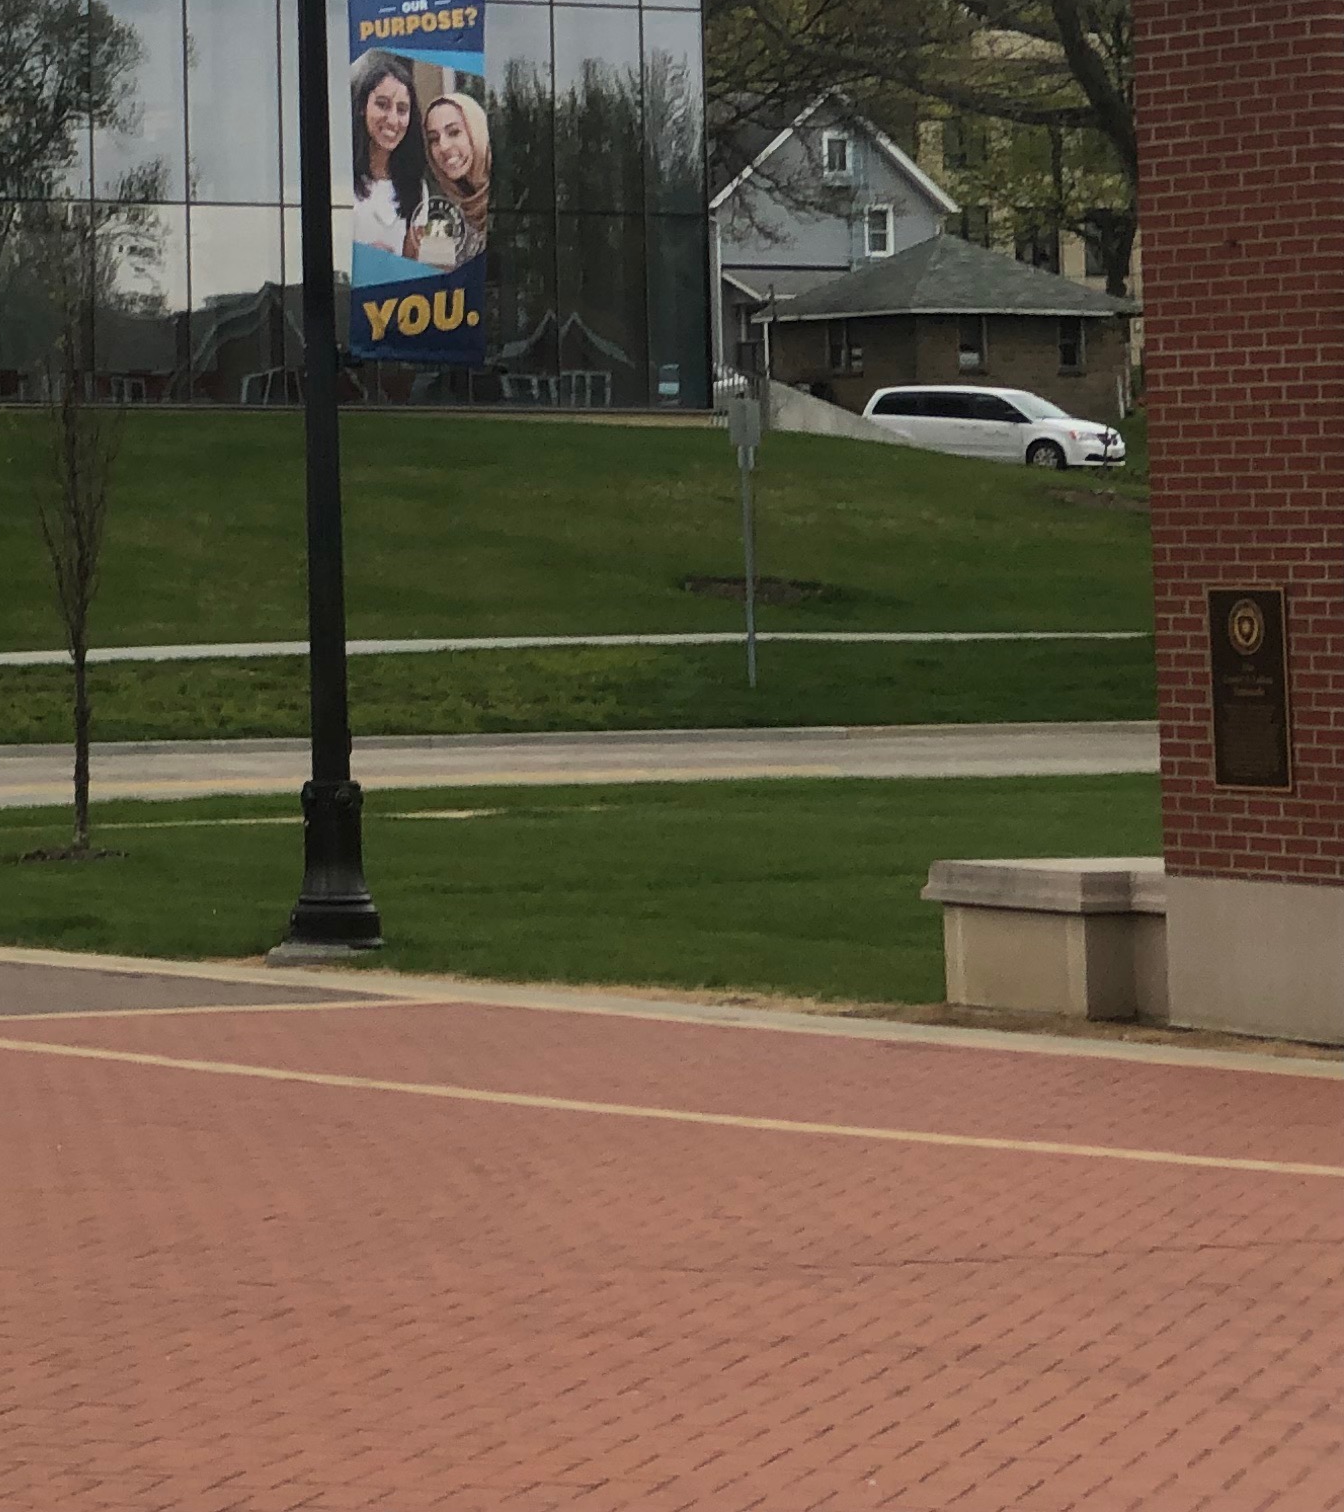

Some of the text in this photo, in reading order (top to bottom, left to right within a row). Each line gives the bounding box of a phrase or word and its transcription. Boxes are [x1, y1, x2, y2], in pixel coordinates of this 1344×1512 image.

[359, 5, 477, 41] PURPOSE?
[401, 0, 428, 13] OUR
[363, 288, 480, 341] YOU.
